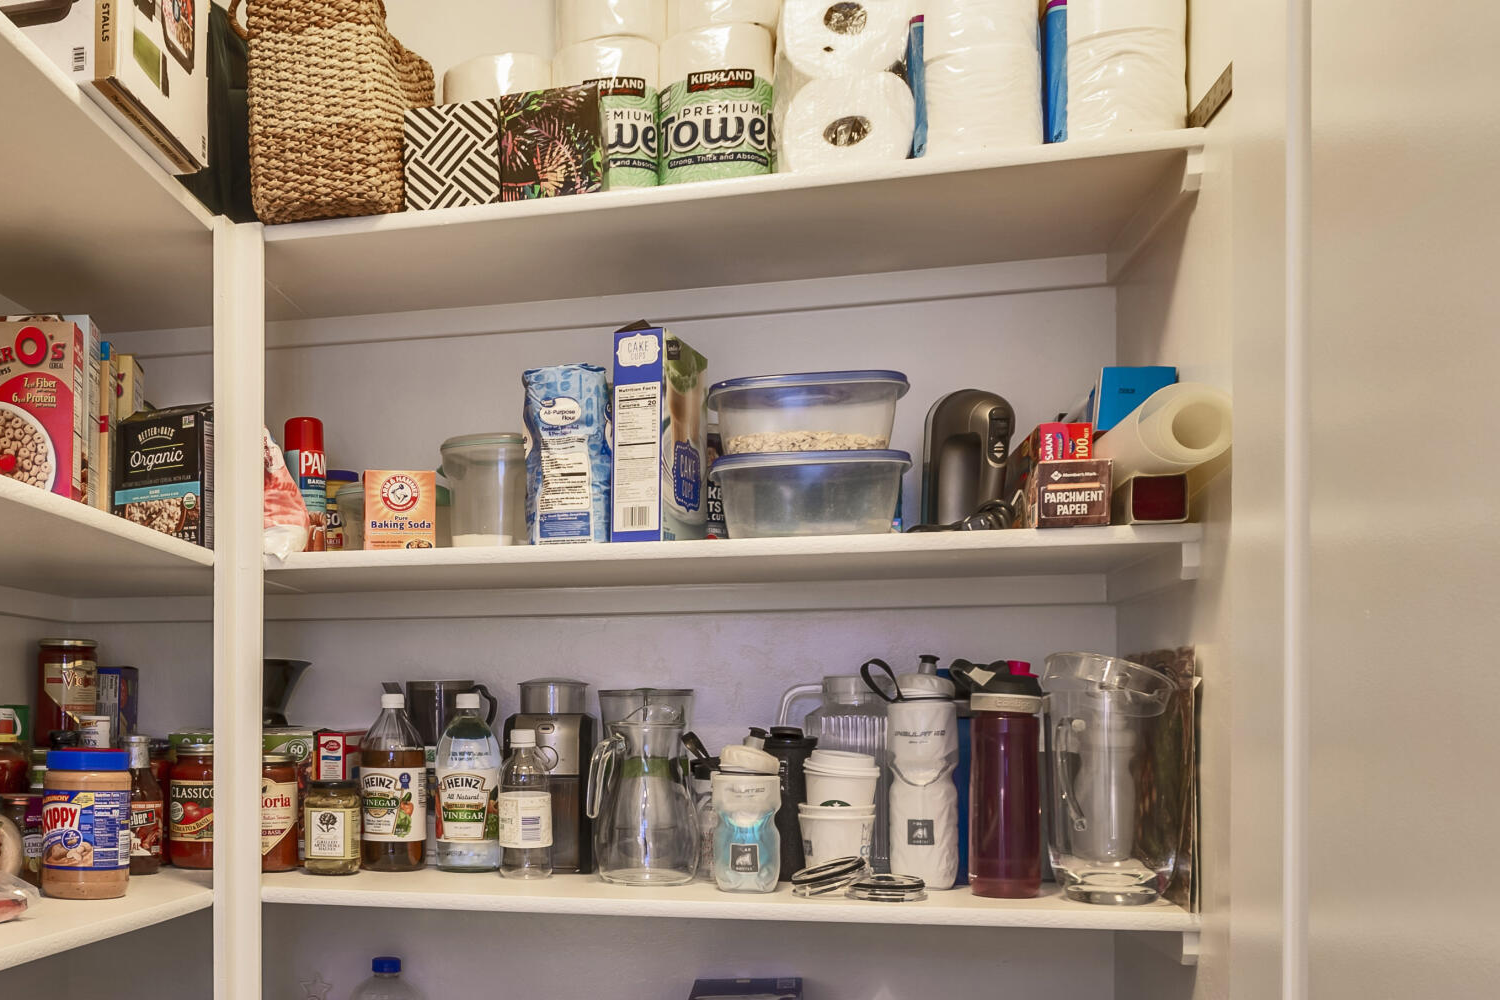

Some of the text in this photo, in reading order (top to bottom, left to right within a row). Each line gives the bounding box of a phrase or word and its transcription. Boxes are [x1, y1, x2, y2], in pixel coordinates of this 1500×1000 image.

[690, 71, 753, 85] KIRKLAND
[682, 105, 761, 118] PREMIUM
[669, 153, 733, 169] Strong, Thick and
[627, 340, 650, 354] CAKE
[630, 352, 647, 361] CUPS
[36, 378, 57, 389] Fiber
[26, 393, 57, 404] Protein
[1044, 433, 1053, 461] SARAN
[1076, 436, 1088, 459] 100
[130, 446, 184, 472] Organic
[680, 459, 697, 482] CAKE
[681, 482, 695, 501] CUPS
[1044, 490, 1104, 504] PARCHMENT
[1056, 503, 1088, 516] PAPER
[371, 520, 431, 531] Baking Soda
[290, 744, 304, 755] 60
[364, 776, 394, 790] HEINZ
[447, 777, 481, 790] HEINZ
[456, 793, 480, 801] Natural
[443, 811, 484, 820] VINEGAR
